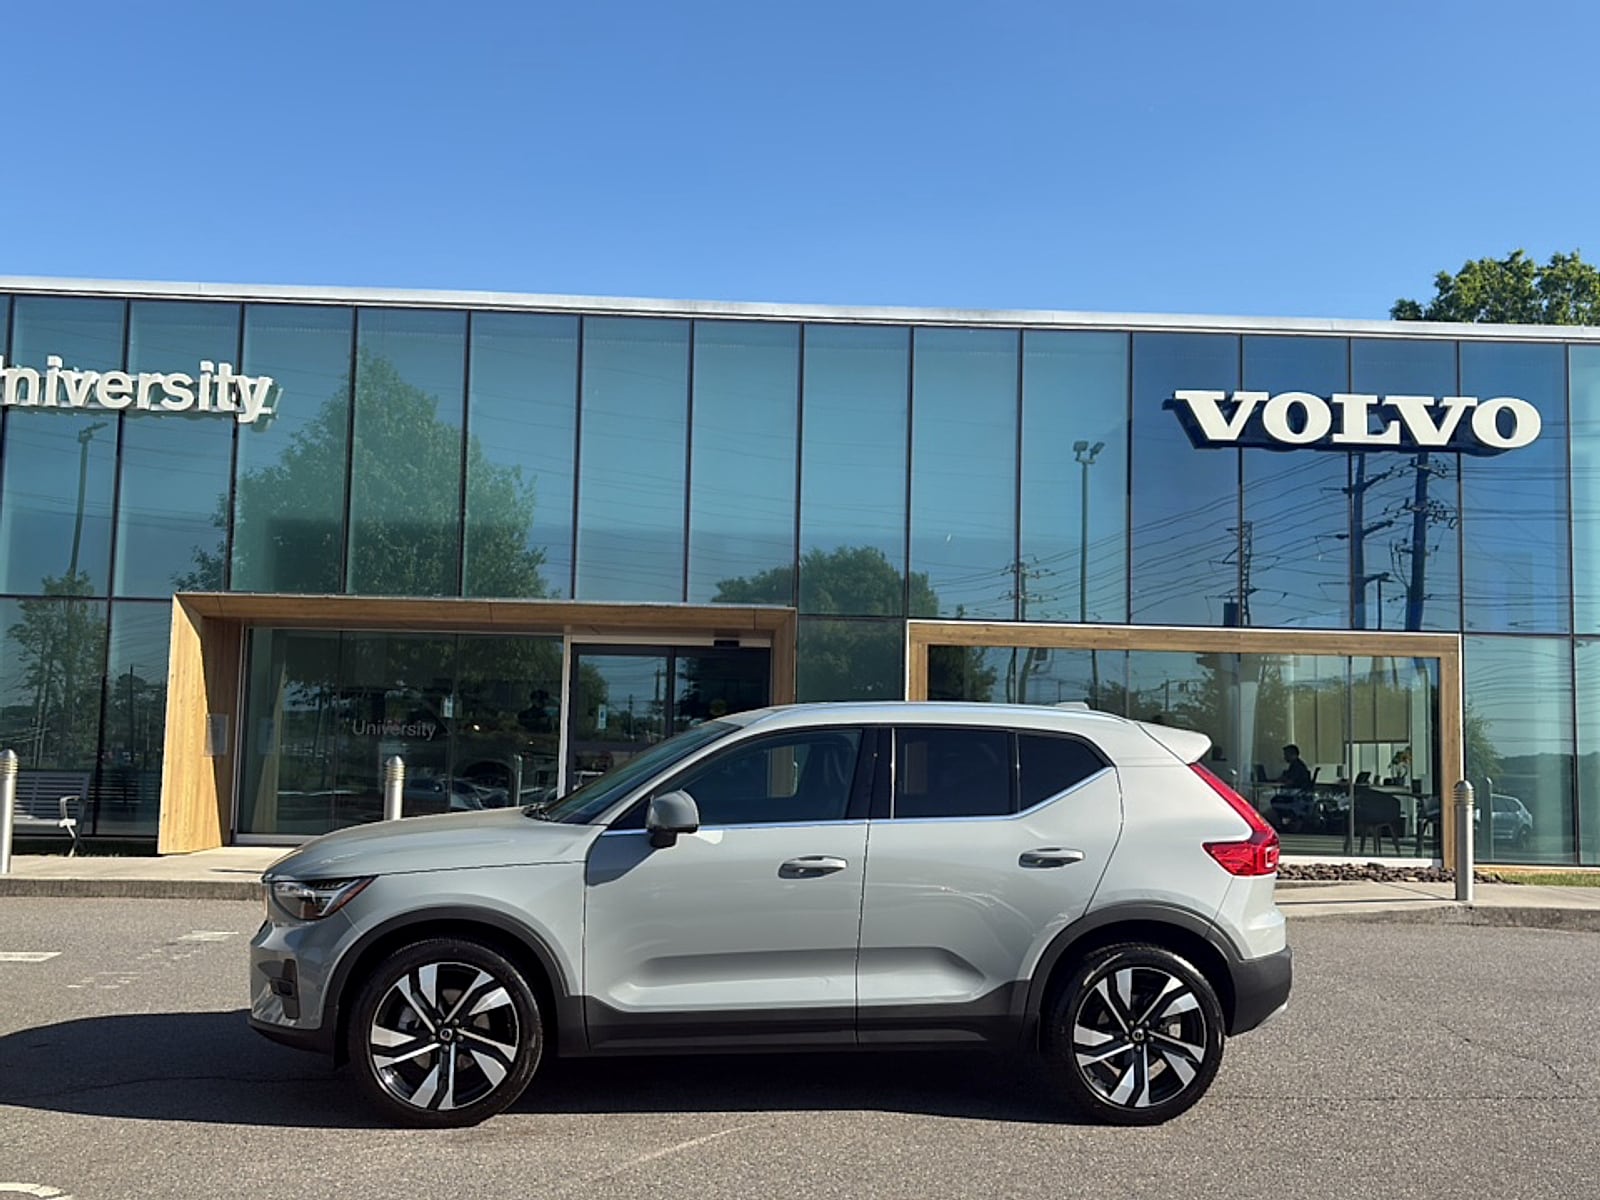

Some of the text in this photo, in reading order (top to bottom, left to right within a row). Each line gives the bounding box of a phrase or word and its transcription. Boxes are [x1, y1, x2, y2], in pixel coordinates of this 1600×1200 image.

[0, 355, 272, 423] niversity
[1174, 390, 1541, 449] VOLVO
[352, 720, 436, 741] University
